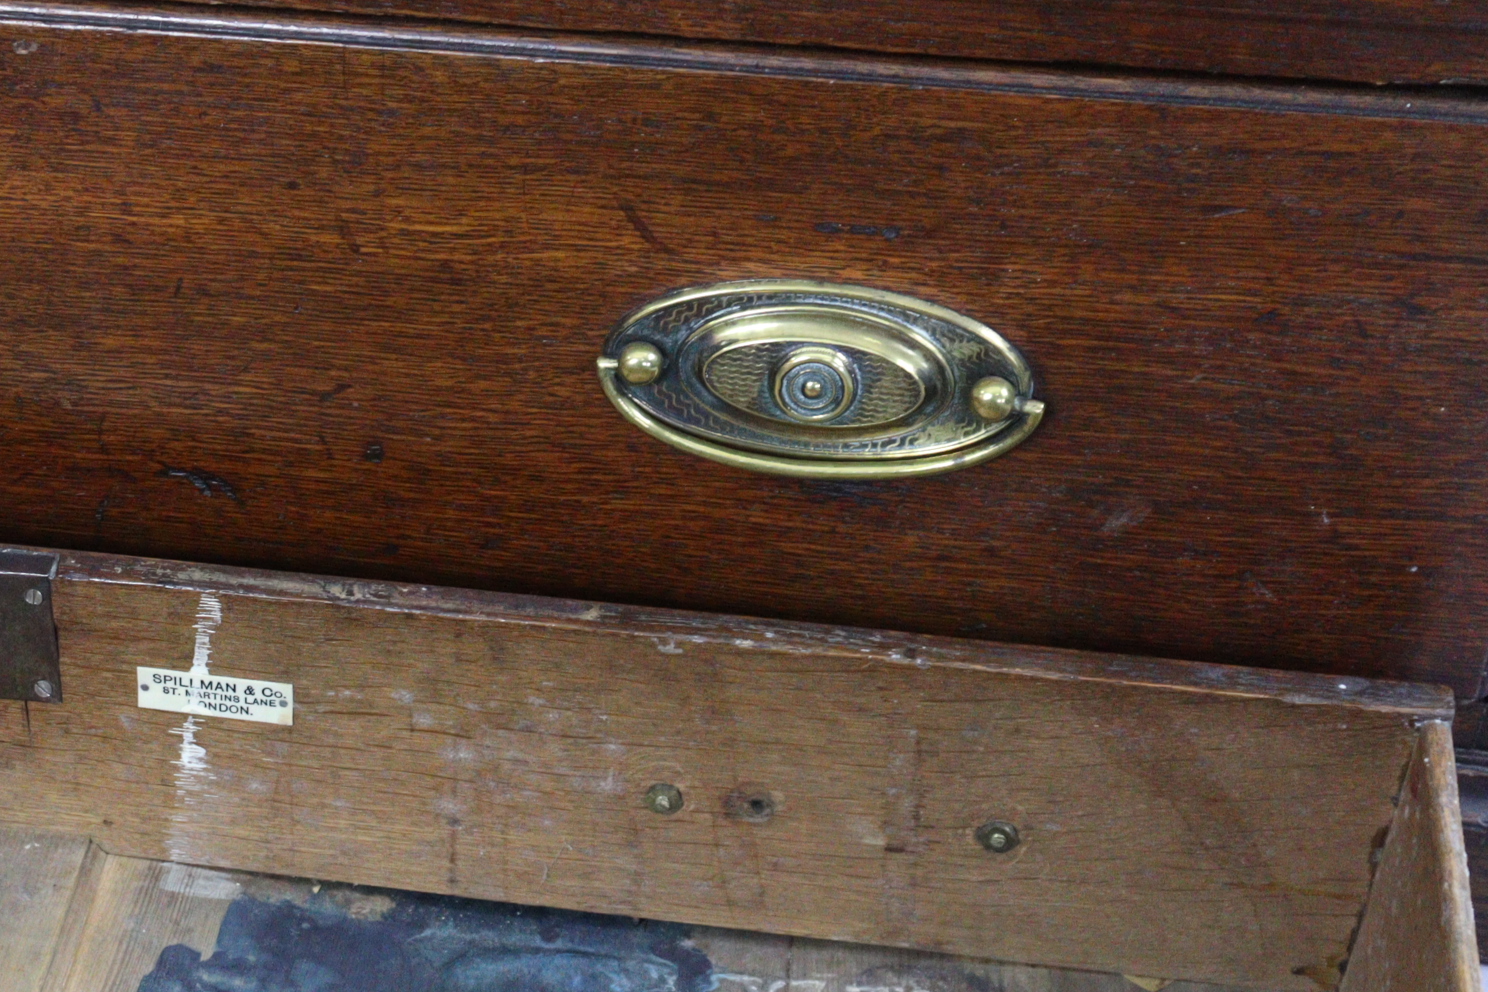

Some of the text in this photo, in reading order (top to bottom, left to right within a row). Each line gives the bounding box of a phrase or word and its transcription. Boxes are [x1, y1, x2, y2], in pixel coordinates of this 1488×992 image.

[152, 673, 287, 699] SPILLMAN & Co.
[162, 687, 181, 696] ST.
[244, 697, 277, 707] LANE
